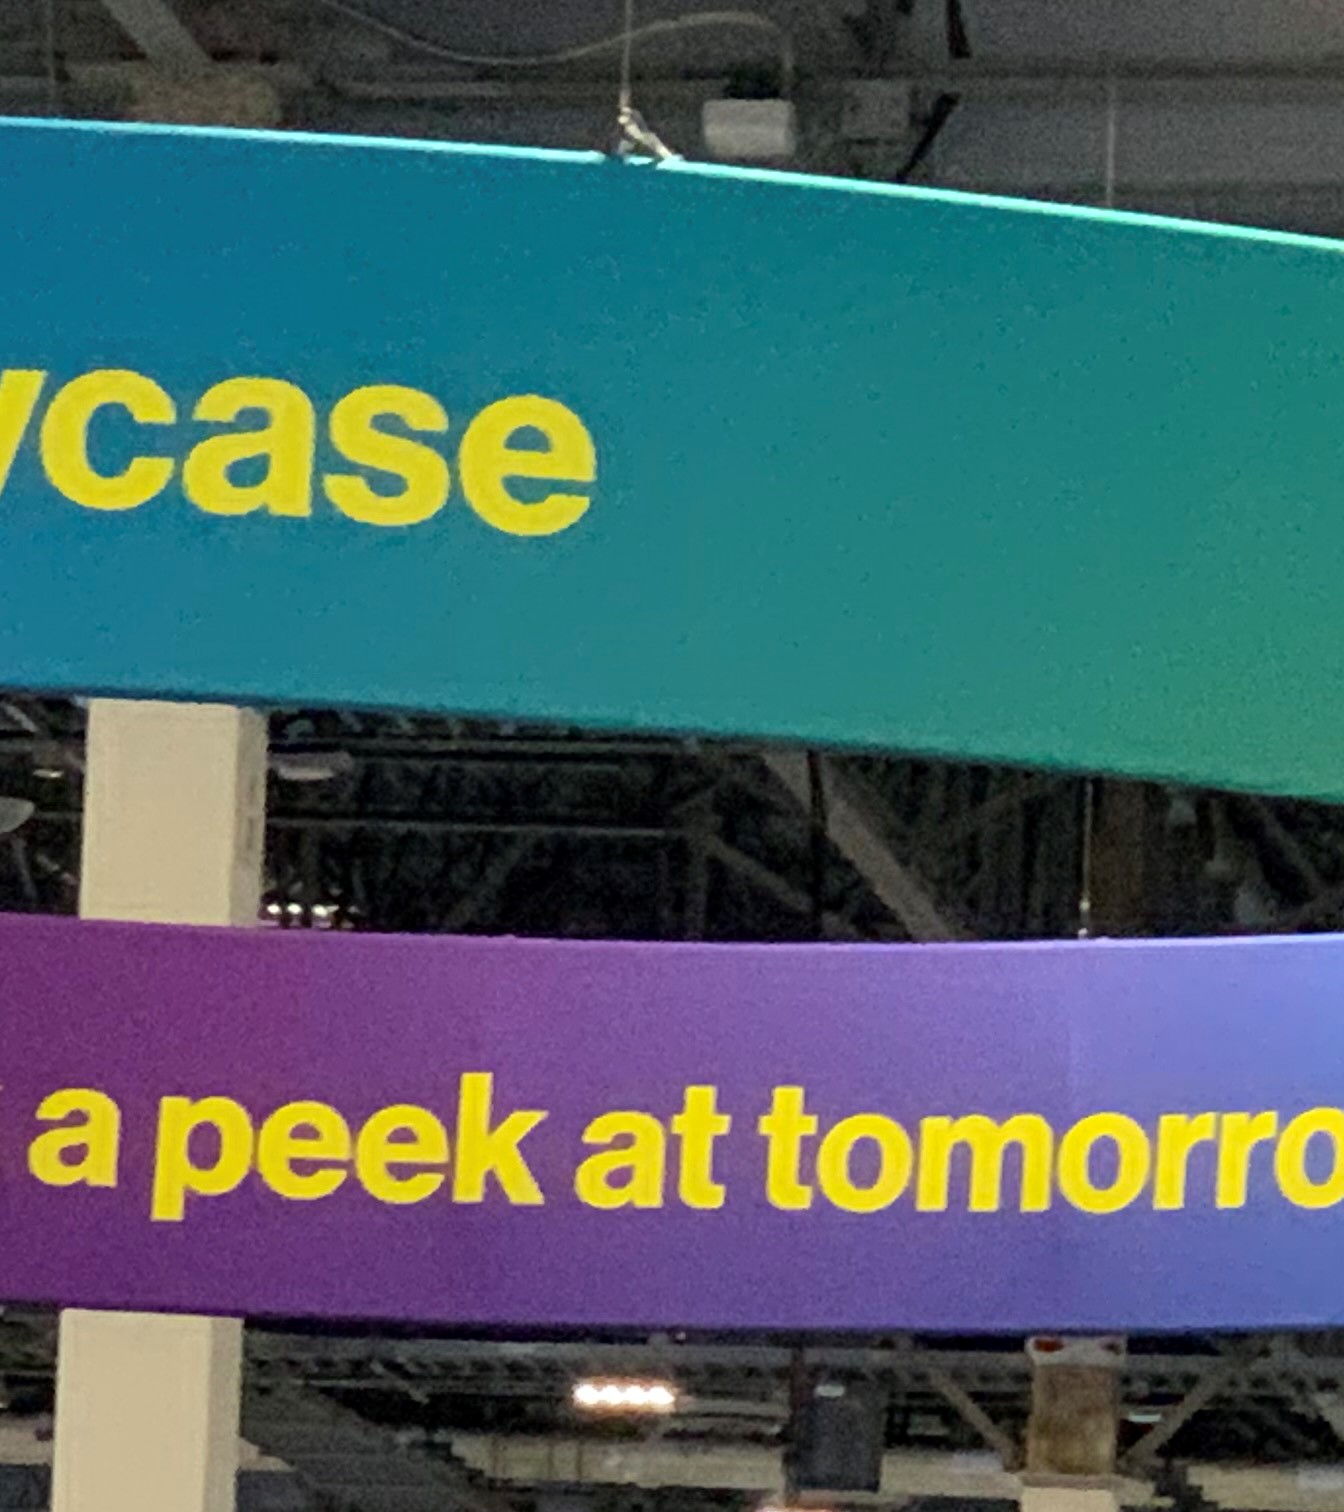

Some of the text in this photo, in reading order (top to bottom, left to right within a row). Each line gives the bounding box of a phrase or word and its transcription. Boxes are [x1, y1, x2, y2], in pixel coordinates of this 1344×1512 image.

[28, 1088, 121, 1187] a
[150, 1071, 549, 1222] peek
[573, 1085, 731, 1210] at
